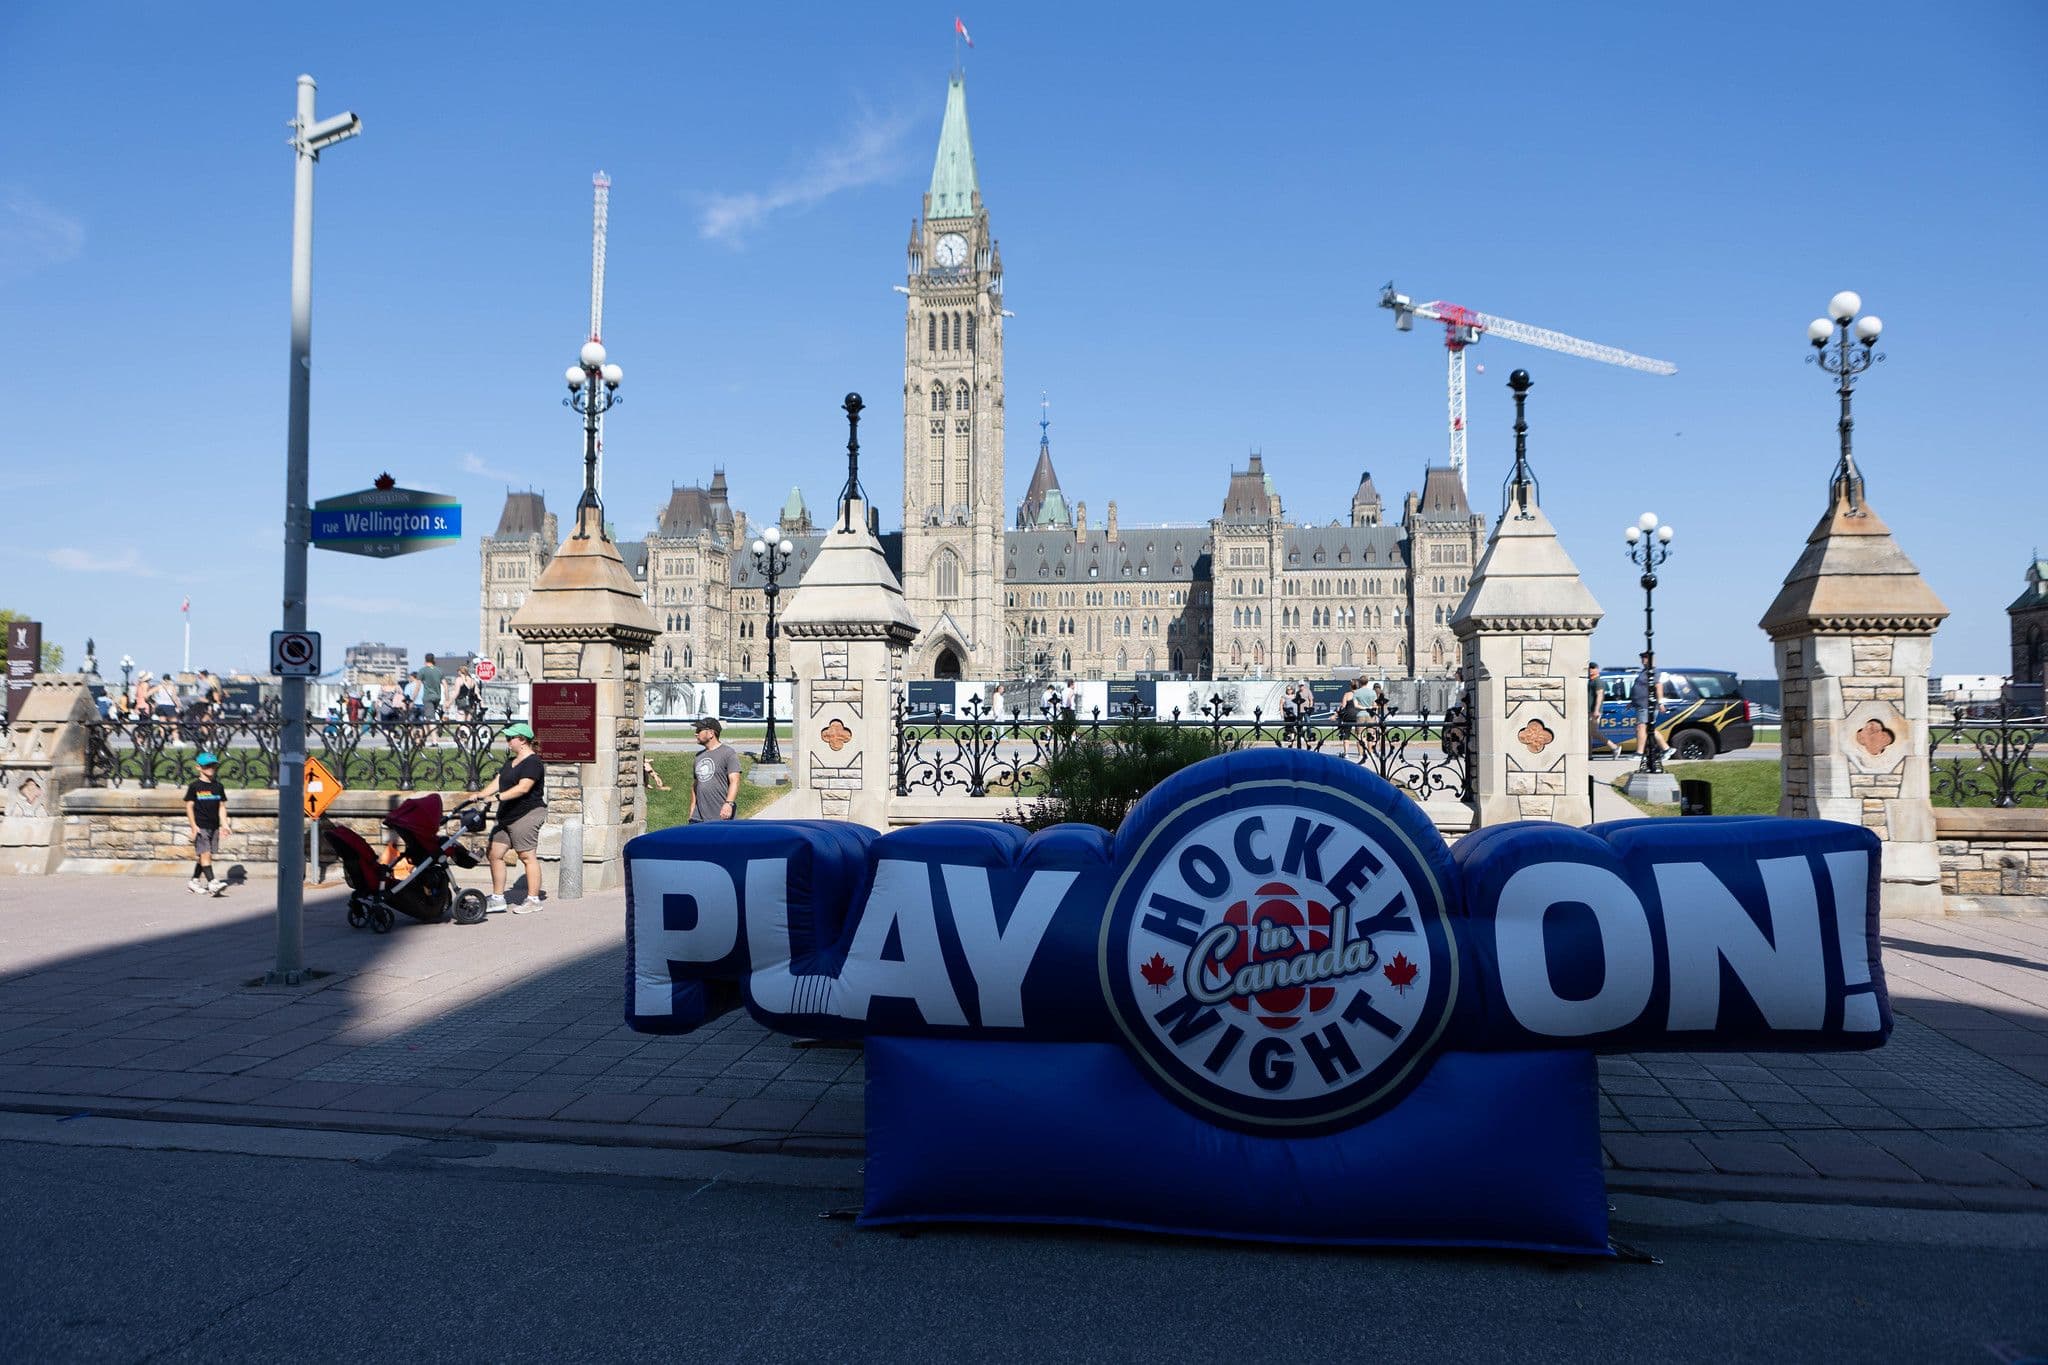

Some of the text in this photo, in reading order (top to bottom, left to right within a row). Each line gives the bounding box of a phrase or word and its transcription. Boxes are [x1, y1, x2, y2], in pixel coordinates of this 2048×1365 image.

[322, 511, 448, 536] rue Wellington St.
[1141, 815, 1416, 947] HOCKEY
[630, 849, 1882, 1037] PLAY ON!
[1185, 903, 1377, 1004] Canada
[1258, 918, 1296, 952] in
[1153, 988, 1404, 1091] NIGHT
